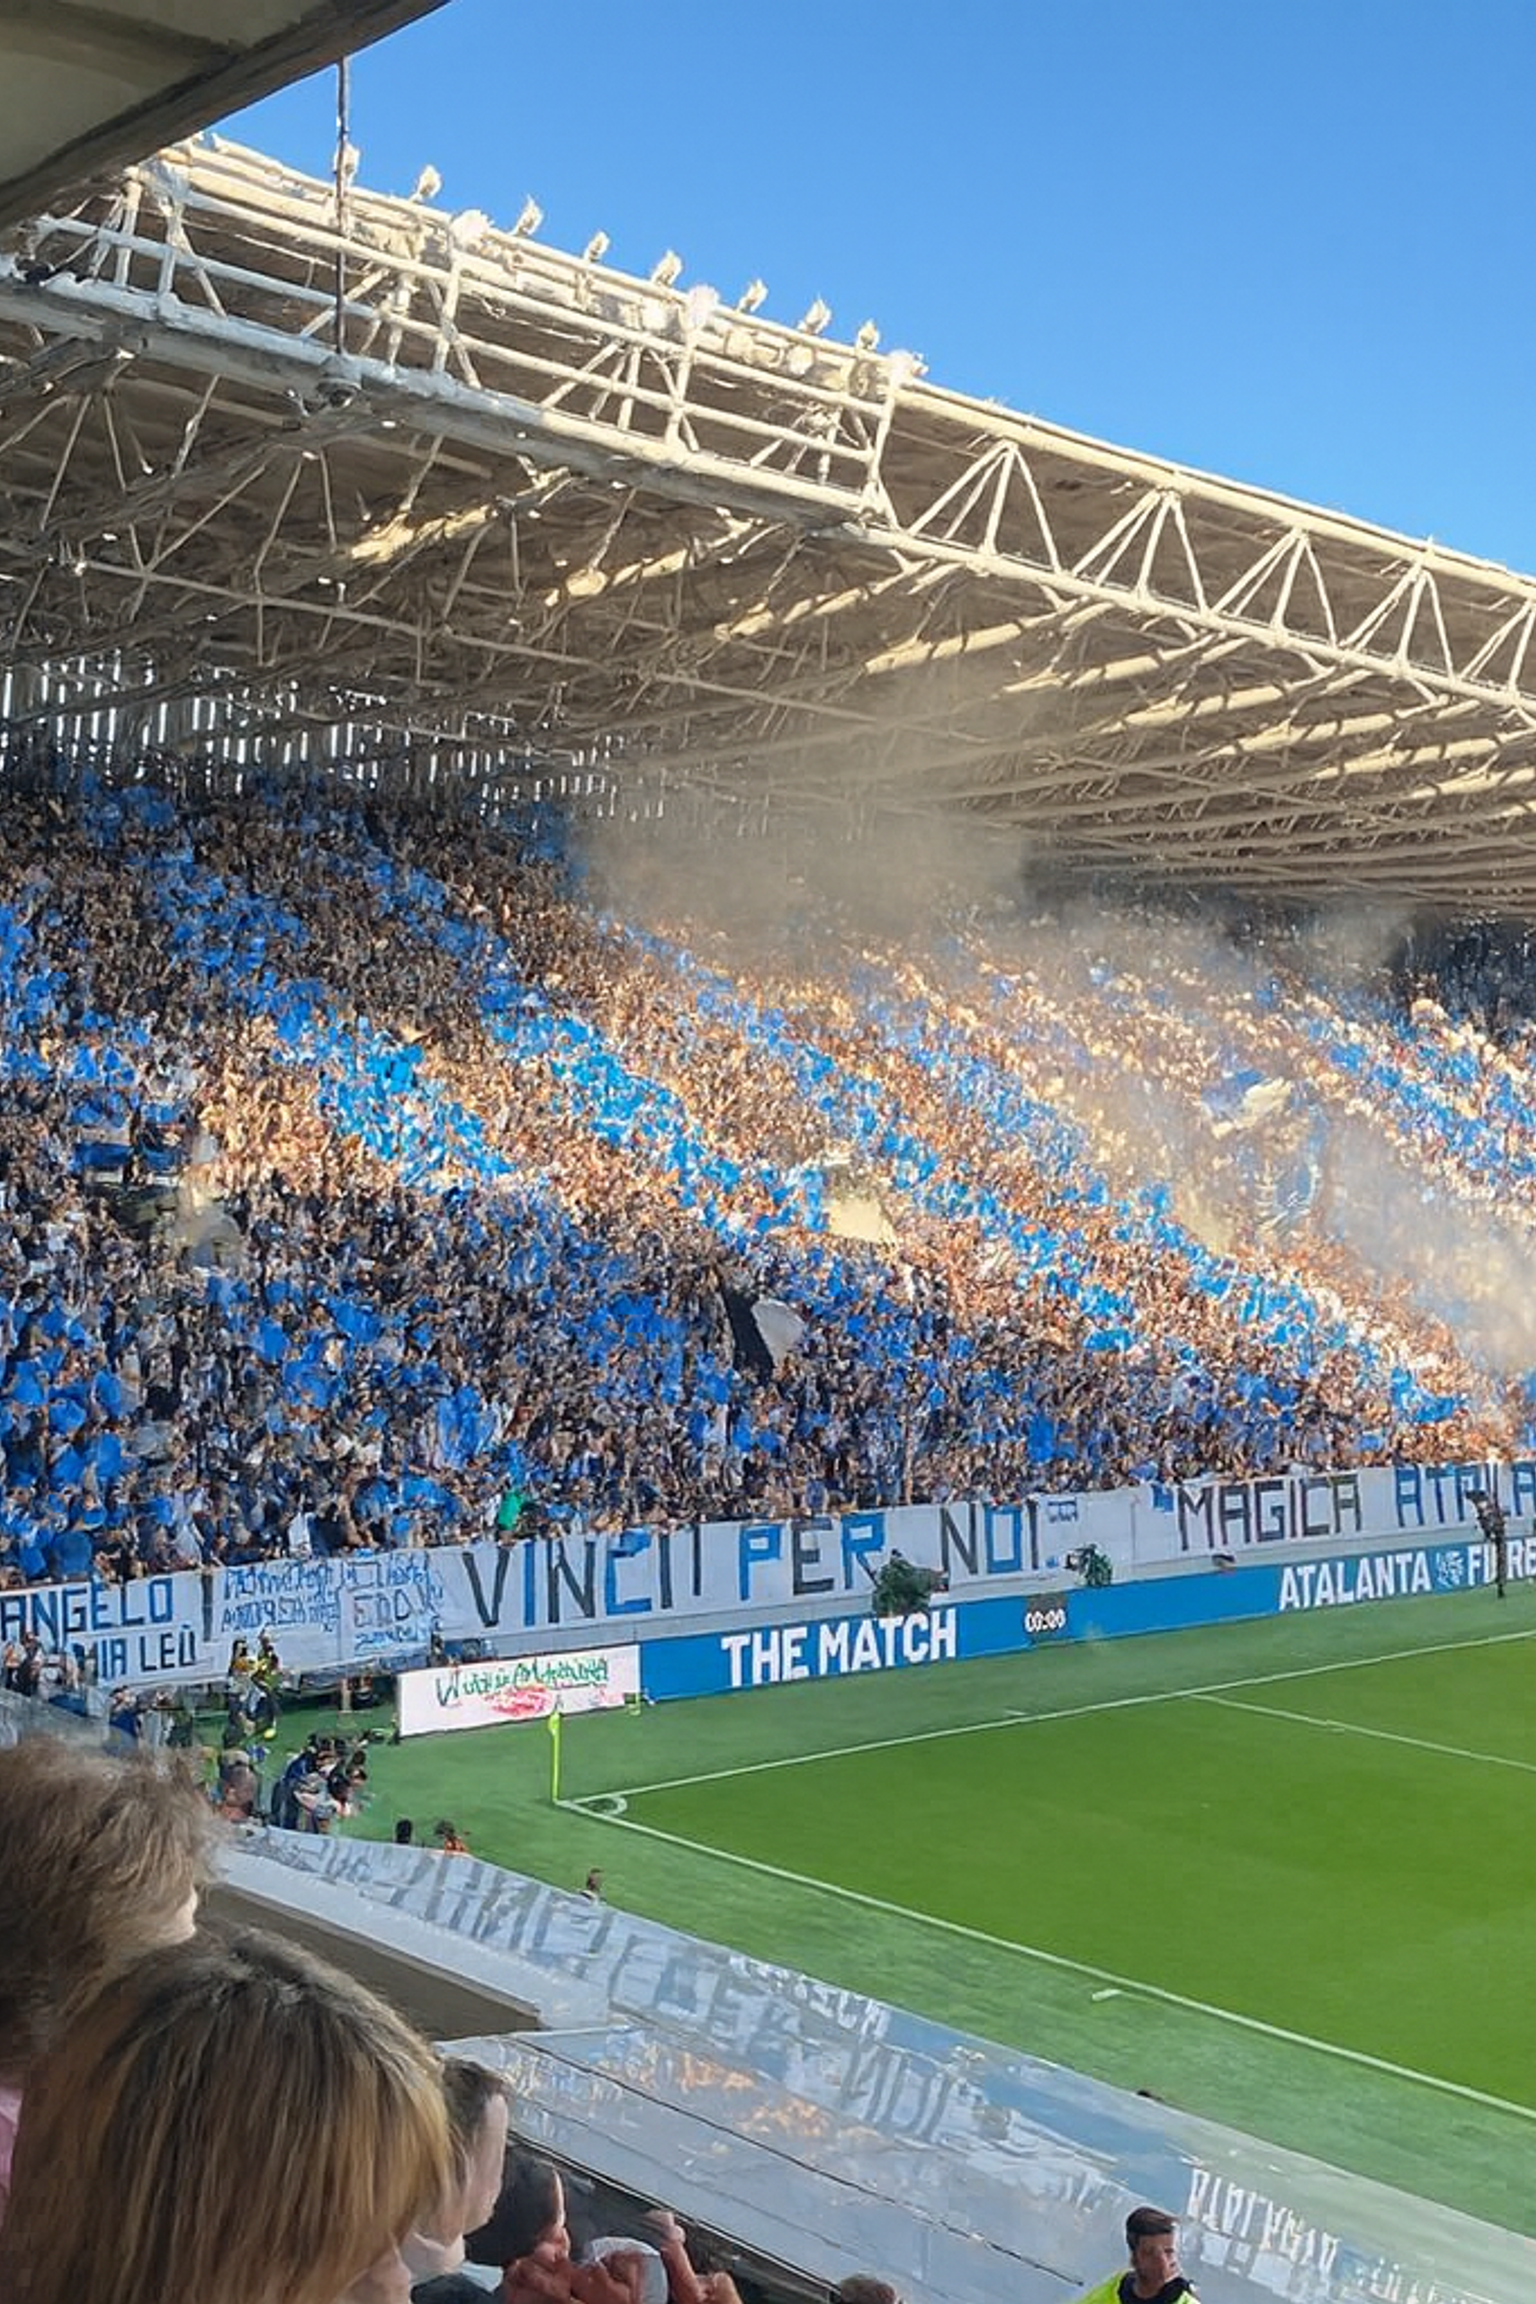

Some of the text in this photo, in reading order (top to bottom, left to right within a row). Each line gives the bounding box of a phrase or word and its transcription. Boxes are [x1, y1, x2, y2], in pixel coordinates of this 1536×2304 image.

[739, 1512, 886, 1601] PER
[939, 1498, 1040, 1576] NOI
[1177, 1474, 1362, 1551] MAGICA
[0, 1578, 174, 1653] ANGELO
[1278, 1550, 1433, 1612] ATALANTA
[721, 1606, 957, 1688] THE MATCH
